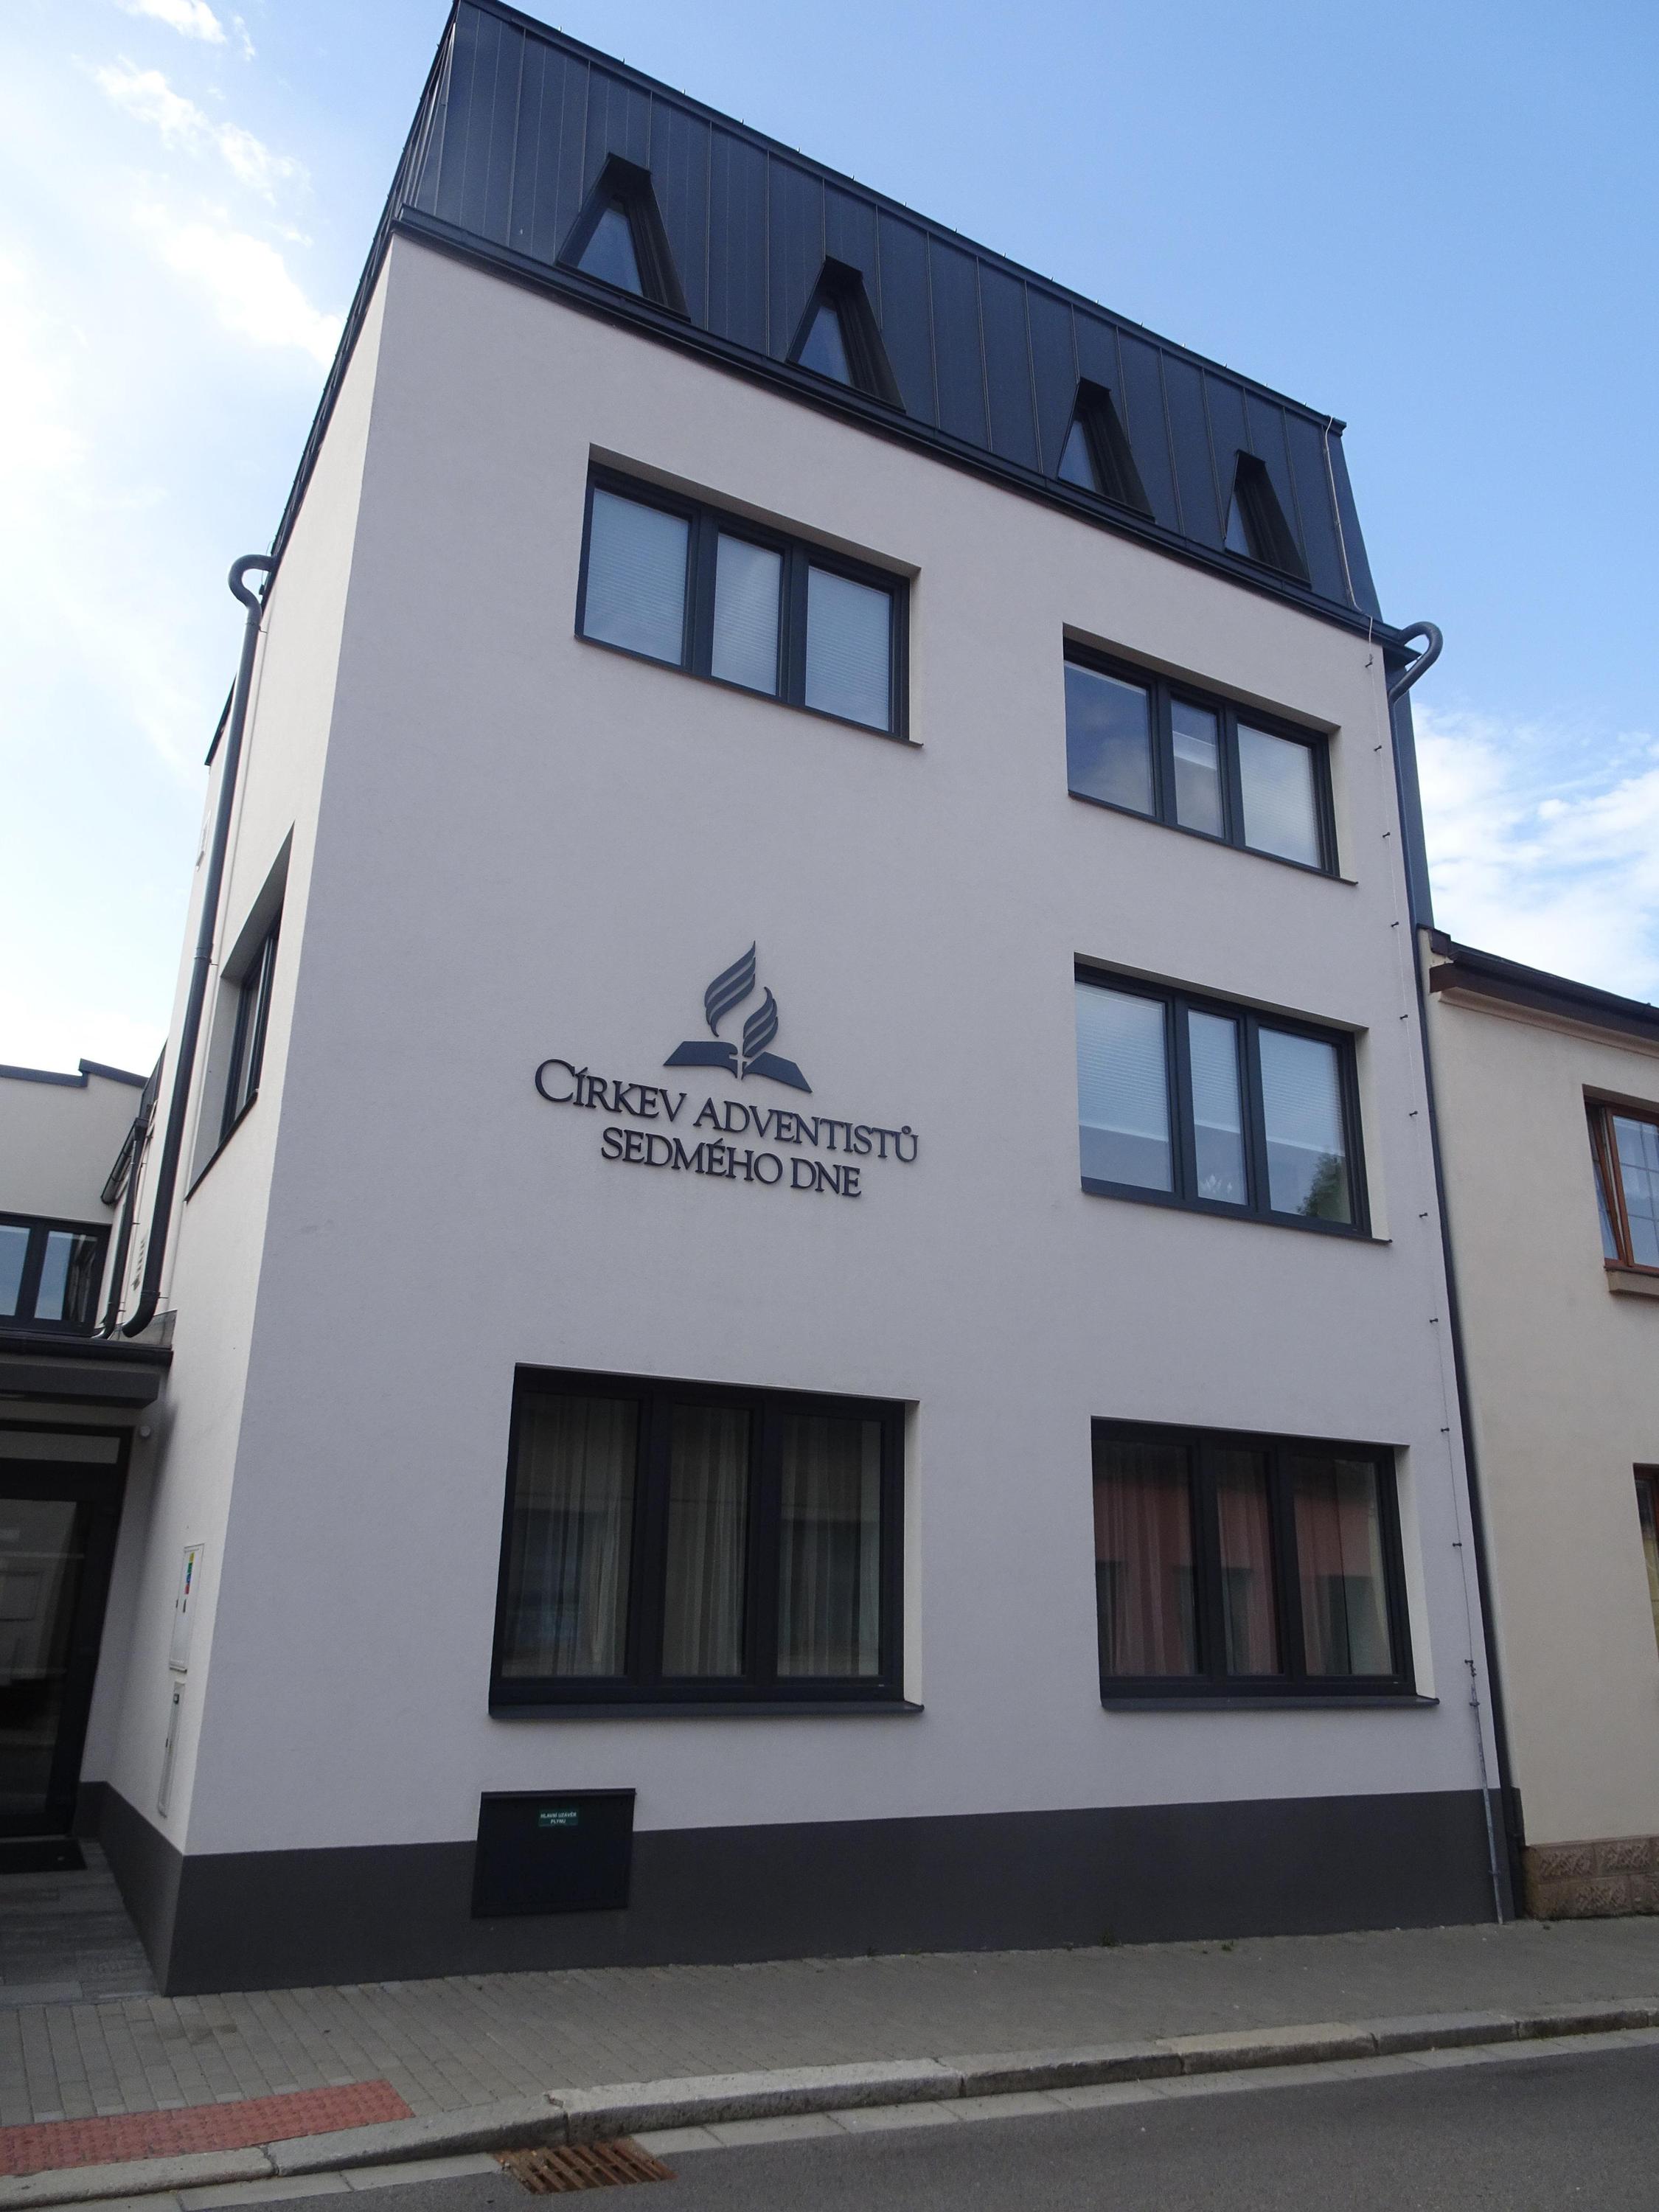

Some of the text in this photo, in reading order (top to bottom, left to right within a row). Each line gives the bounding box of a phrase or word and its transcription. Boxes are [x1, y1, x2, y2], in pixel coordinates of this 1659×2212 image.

[535, 1059, 919, 1163] CÍRKEV ADVENTISTŮ
[600, 1127, 861, 1197] SEDMÉHO DNE
